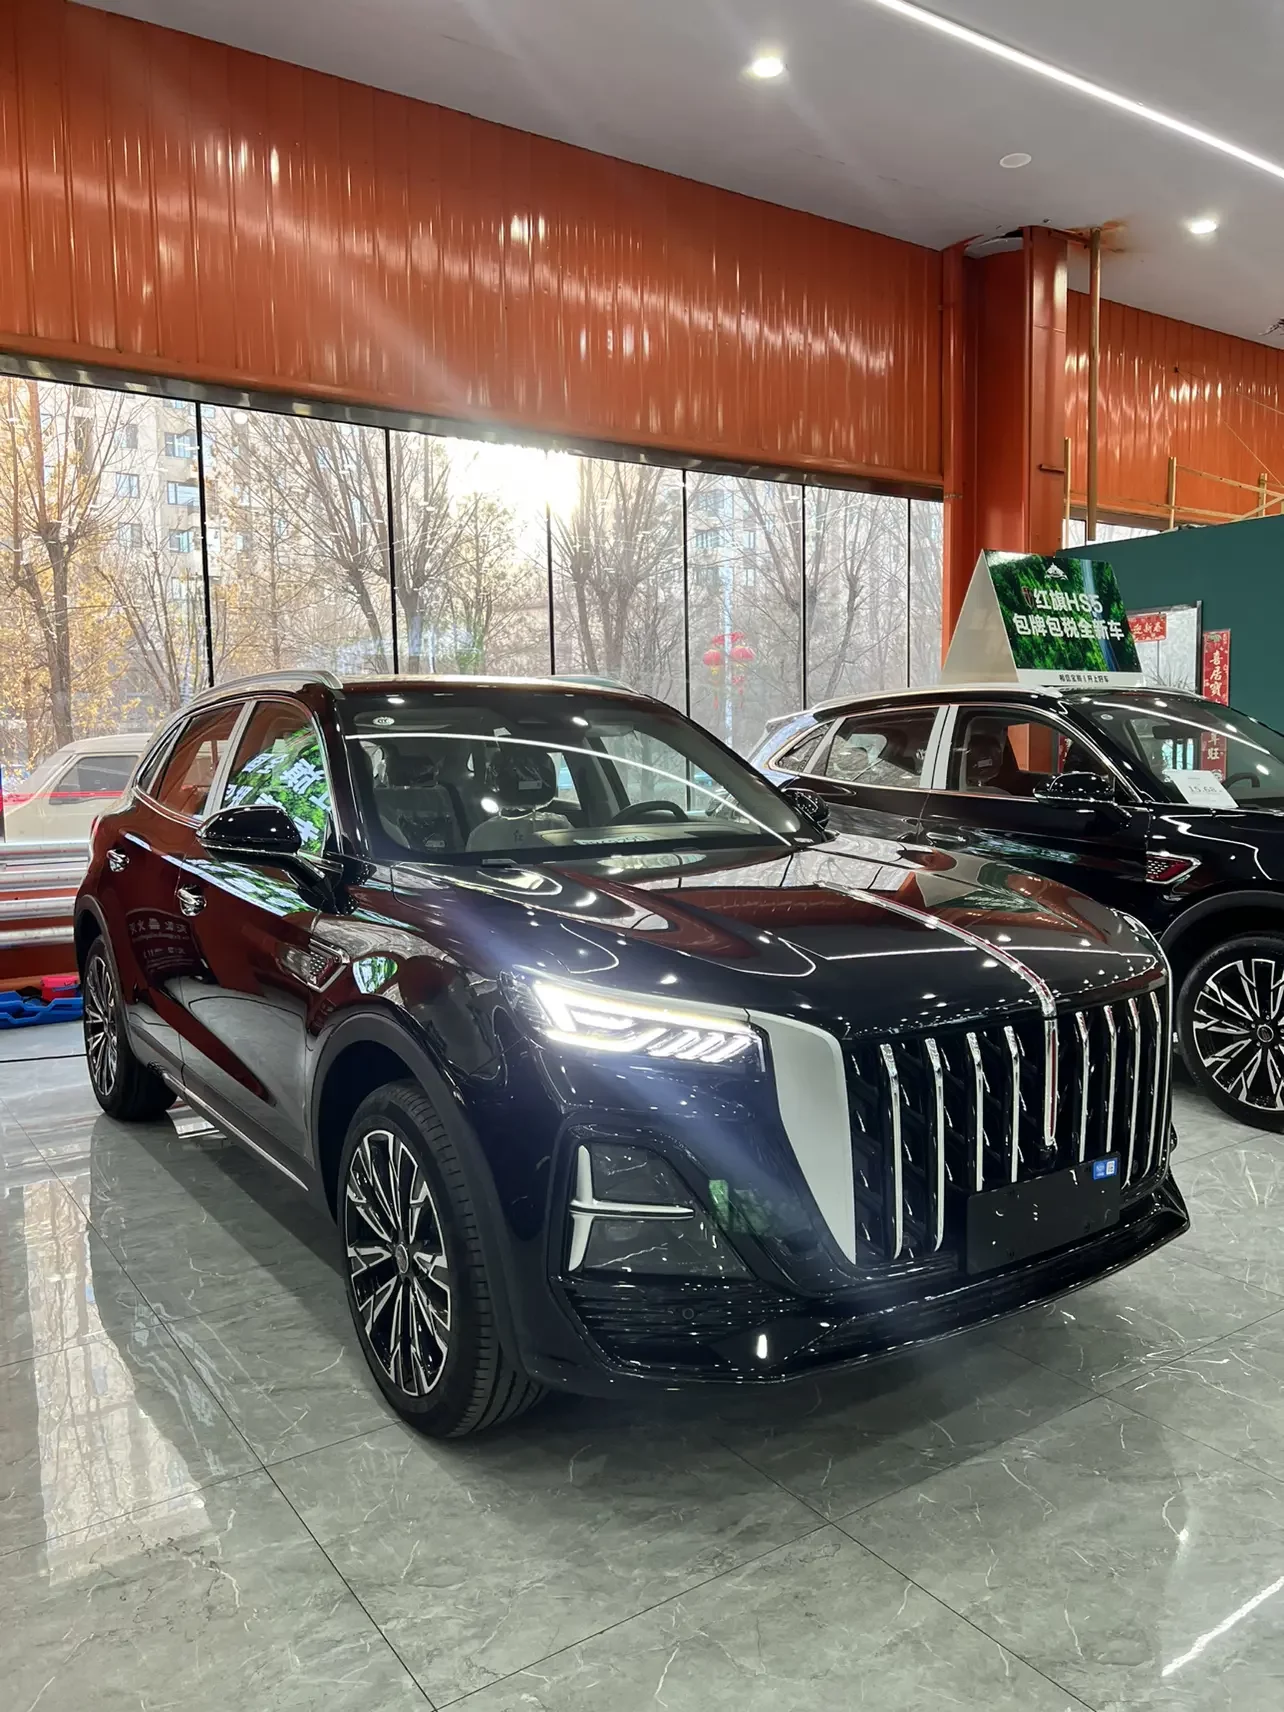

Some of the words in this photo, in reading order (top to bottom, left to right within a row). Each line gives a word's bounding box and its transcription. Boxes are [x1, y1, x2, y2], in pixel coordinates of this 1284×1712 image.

[1033, 588, 1104, 614] 红旗HS5
[1012, 612, 1125, 641] 包牌包税全新车
